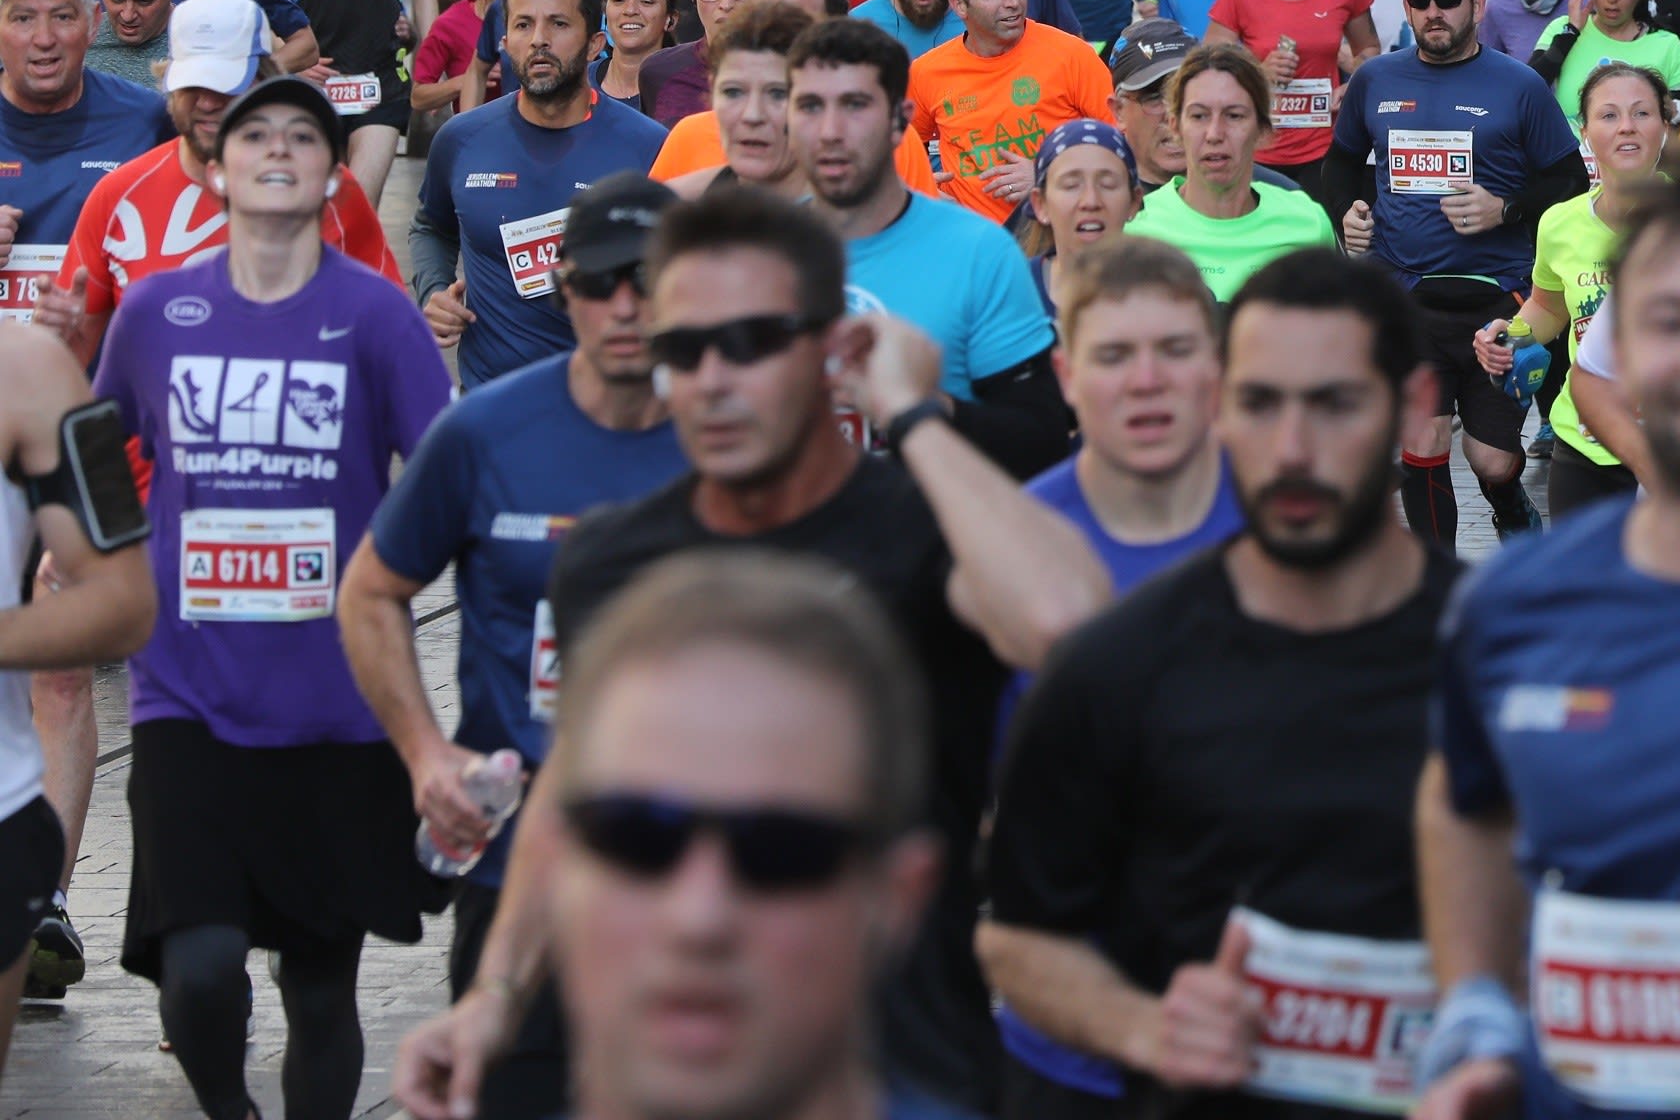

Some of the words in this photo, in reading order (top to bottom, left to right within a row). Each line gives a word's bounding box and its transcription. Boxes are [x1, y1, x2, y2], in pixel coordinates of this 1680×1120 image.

[331, 86, 357, 101] 2726
[1280, 96, 1308, 112] 2327
[1455, 105, 1484, 114] saucony
[81, 160, 119, 170] saucony
[1394, 156, 1403, 168] B
[1409, 154, 1443, 172] 4530
[465, 180, 496, 188] MARATHON
[467, 173, 498, 181] JERUSALEM
[516, 254, 528, 268] C
[172, 446, 338, 481] Run4Purple
[192, 556, 207, 575] A
[218, 549, 280, 583] 6714
